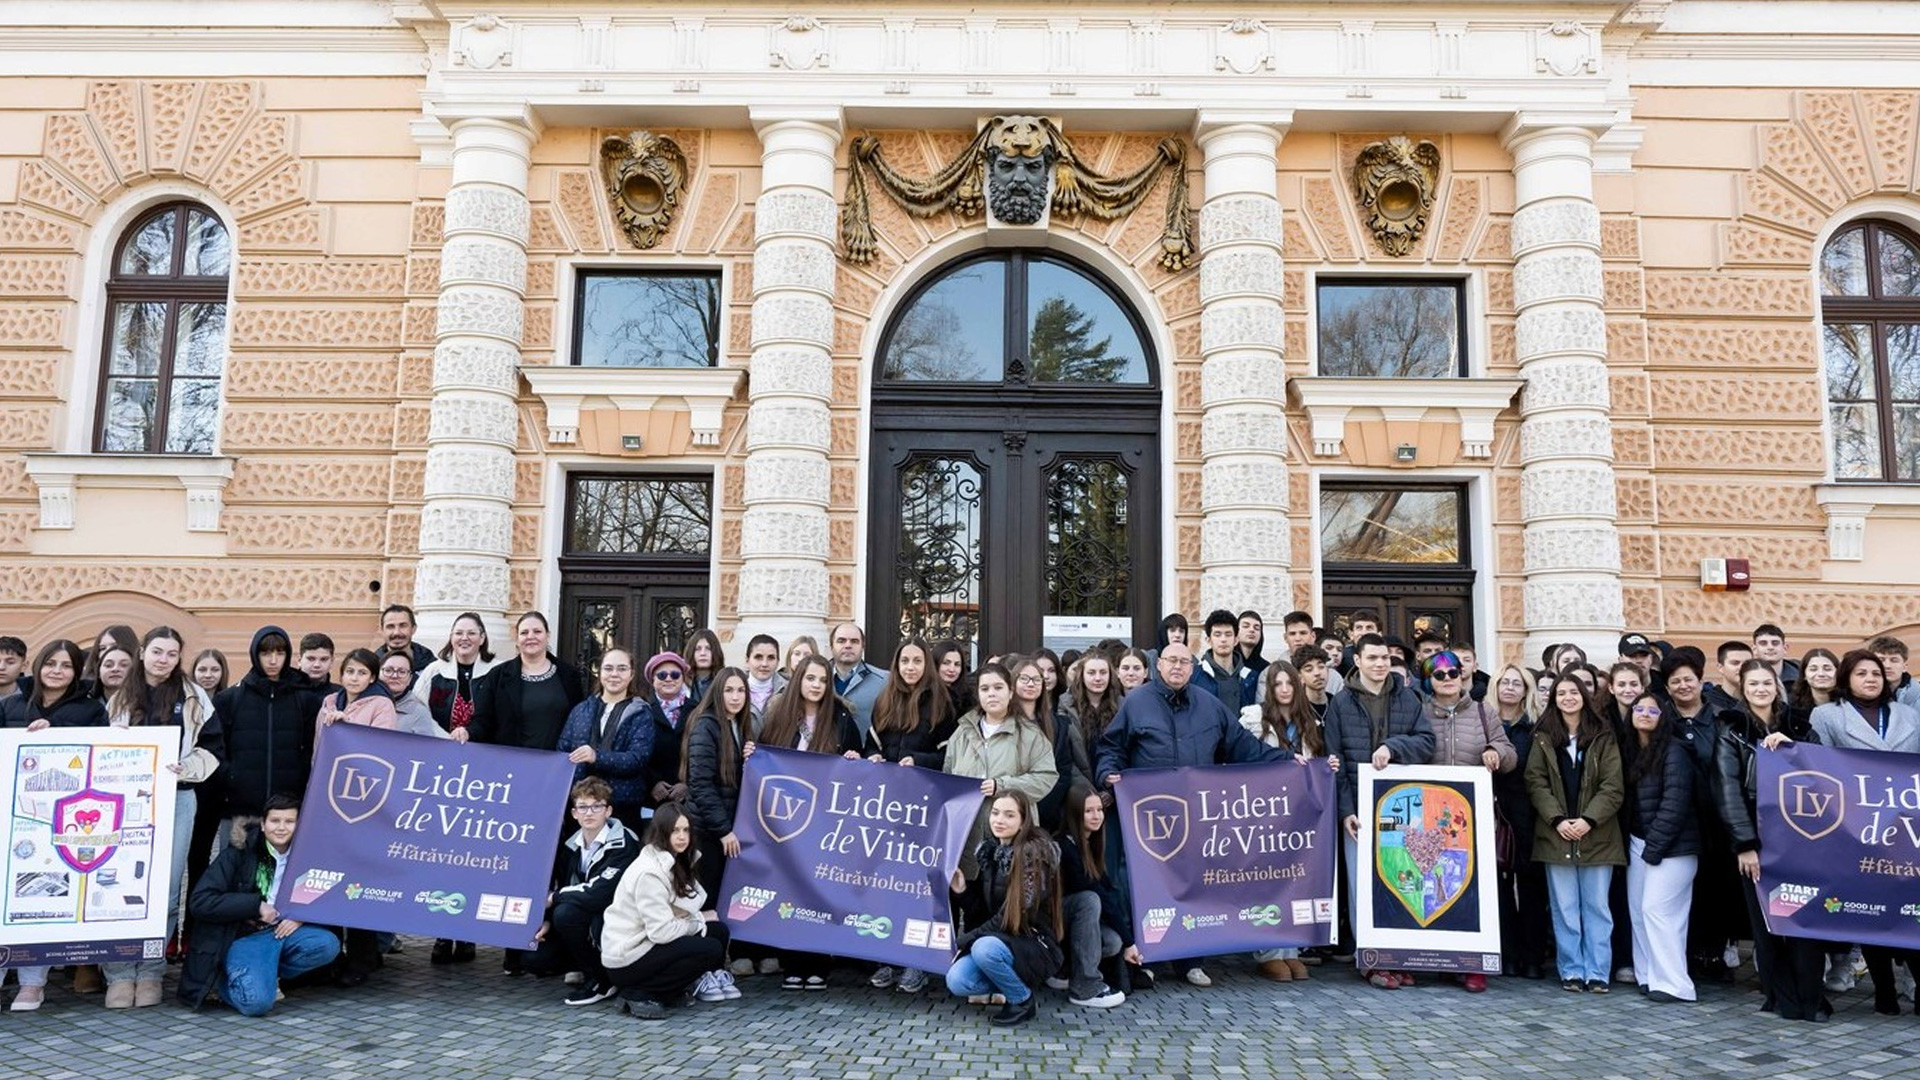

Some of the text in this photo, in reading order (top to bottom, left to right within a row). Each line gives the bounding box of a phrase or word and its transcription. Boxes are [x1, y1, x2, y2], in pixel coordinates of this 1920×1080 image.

[403, 760, 513, 804] Lideri
[826, 781, 929, 828] Lideri
[1198, 784, 1291, 822] Lideri
[394, 798, 535, 844] de Viitor
[1861, 811, 1898, 846] de
[820, 819, 855, 855] de
[1202, 824, 1316, 858] de Viitor
[387, 841, 510, 874] #fărăviolență
[307, 869, 345, 881] START
[1203, 863, 1306, 885] #fărăviolență
[305, 879, 332, 890] ONG
[814, 863, 932, 900] #fărăviolență
[364, 887, 403, 899] GOOD LIFE
[742, 886, 777, 900] START
[1780, 882, 1819, 896] START
[740, 896, 765, 908] ONG
[1780, 892, 1808, 904] ONG
[1148, 907, 1176, 918] START
[1844, 901, 1886, 912] GOOD LIFE
[796, 908, 832, 920] GOOD LIFE
[1150, 918, 1170, 928] ONG
